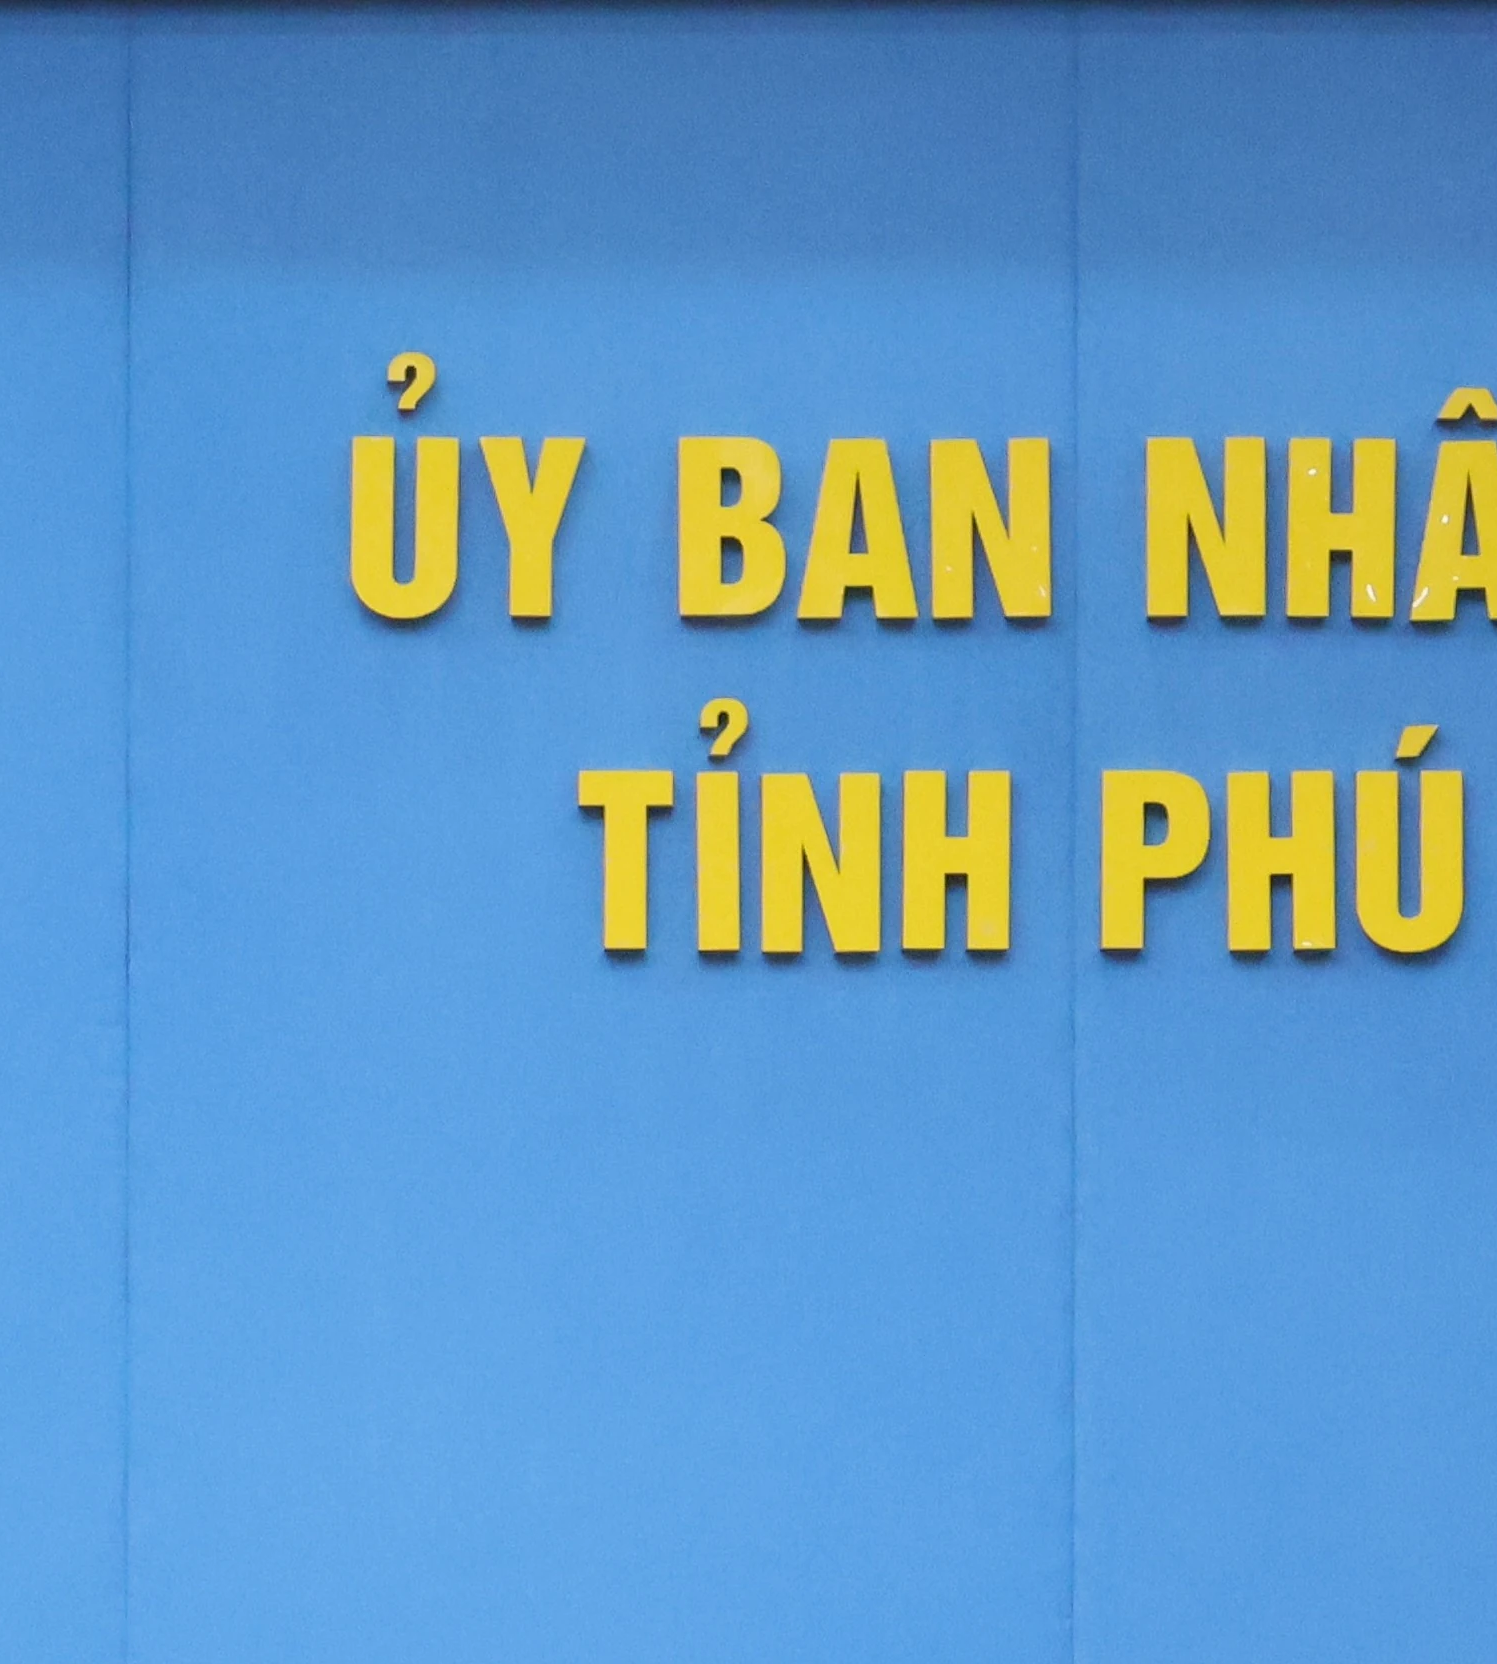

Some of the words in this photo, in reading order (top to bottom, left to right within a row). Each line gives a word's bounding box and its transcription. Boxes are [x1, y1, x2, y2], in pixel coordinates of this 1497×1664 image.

[350, 353, 586, 621] ỦY
[679, 437, 1052, 620] BAN
[578, 698, 1011, 954] TỈNH
[1100, 725, 1465, 955] PHÚ
